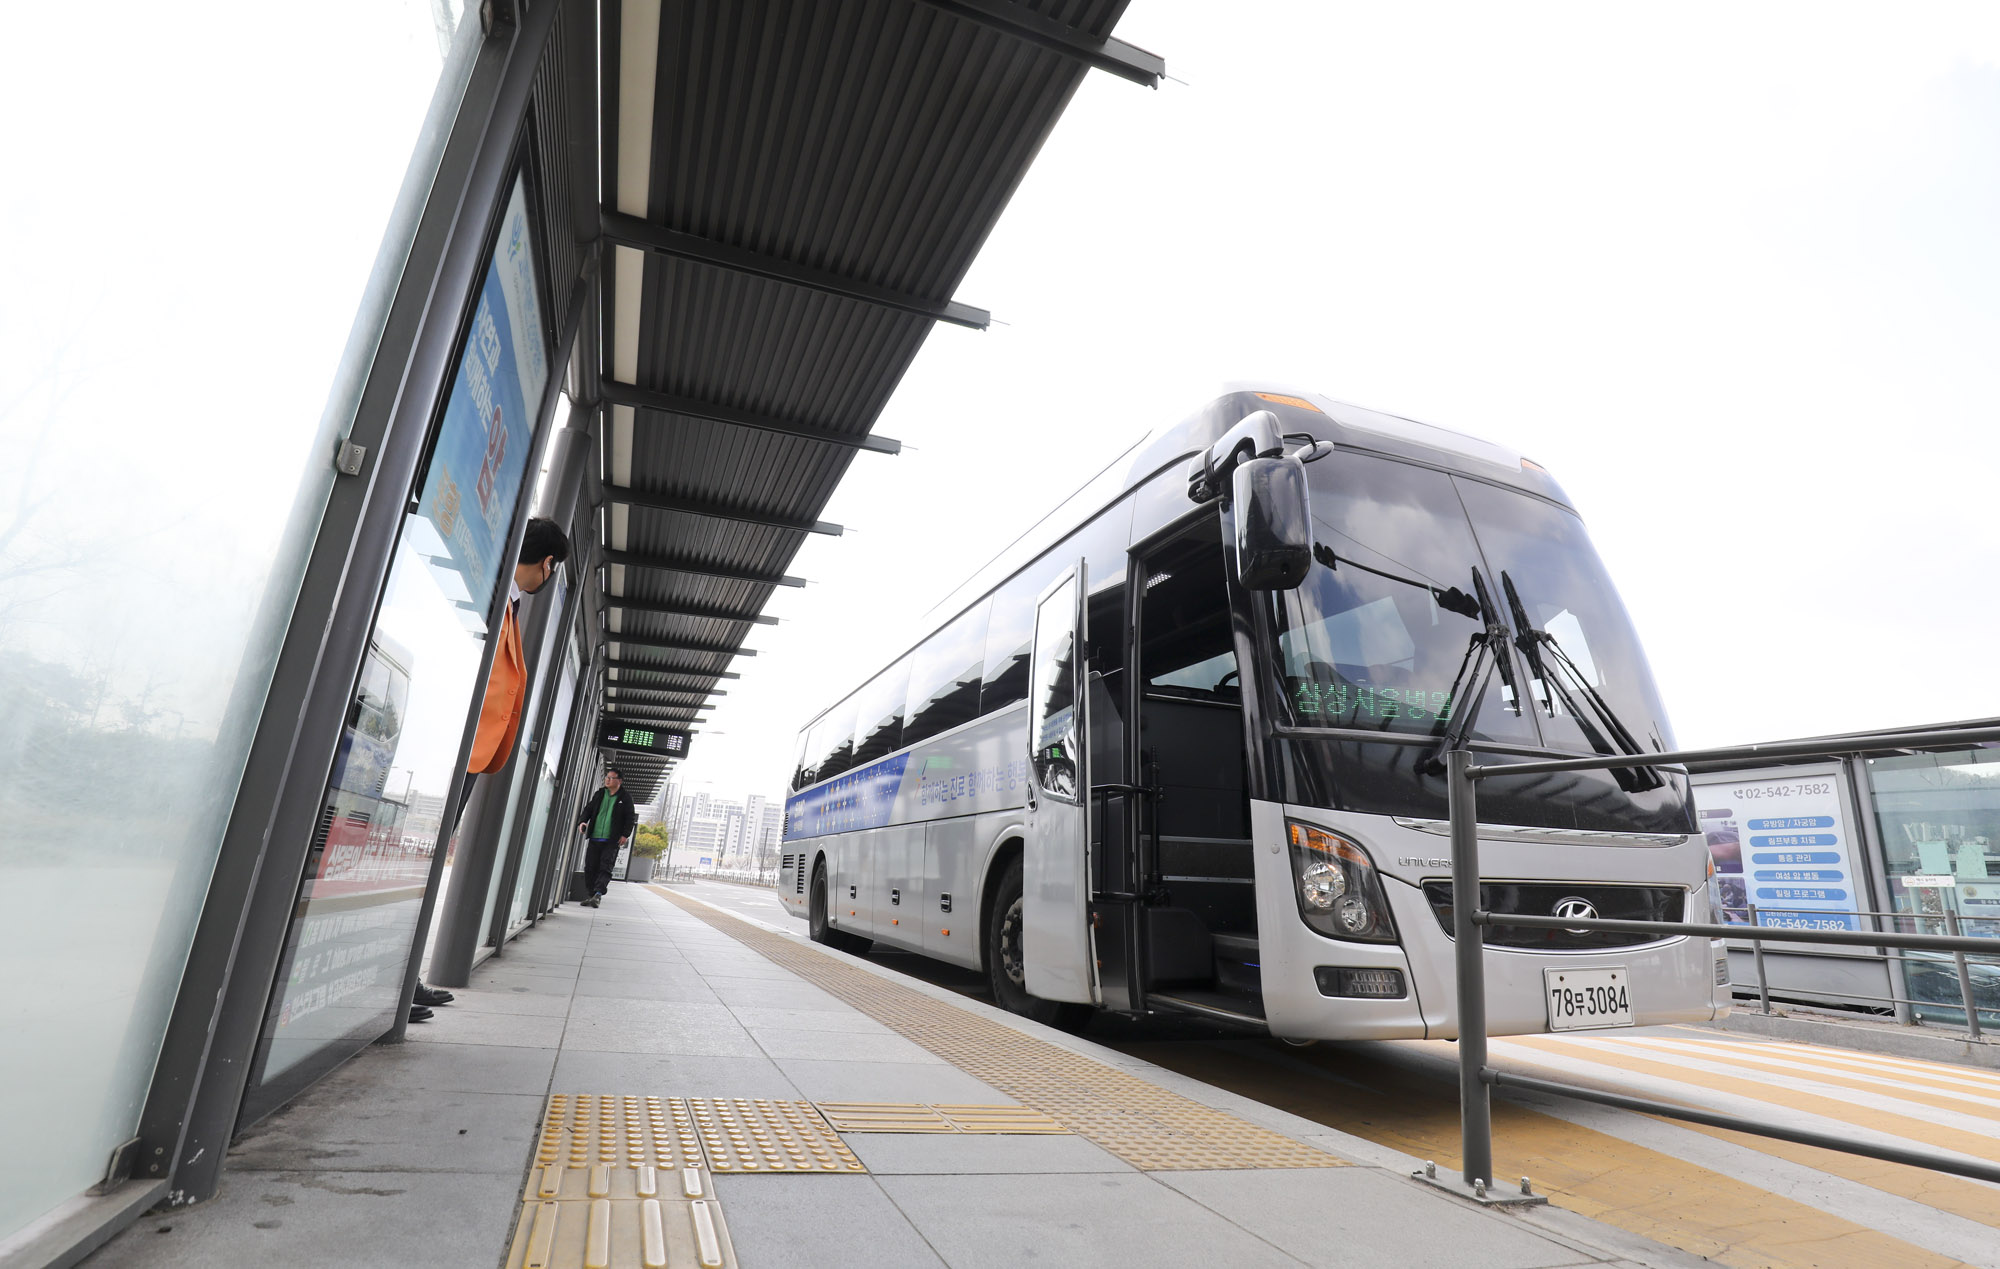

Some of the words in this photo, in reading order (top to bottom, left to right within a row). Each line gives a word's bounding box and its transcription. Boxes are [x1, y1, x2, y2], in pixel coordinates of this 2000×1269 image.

[478, 291, 502, 378] 자연과
[1295, 682, 1453, 721] 삼성서울병원
[921, 780, 948, 806] 함께하는
[950, 776, 965, 801] 진료
[968, 766, 1004, 797] 함께하는
[1745, 783, 1830, 799] 02-542-7582
[1762, 819, 1785, 828] 유방암
[1793, 818, 1817, 827] 자궁암
[1768, 836, 1798, 845] 림프부종
[1800, 836, 1816, 844] 치료
[1795, 854, 1812, 862] 관리
[1775, 872, 1791, 880] 여성
[1793, 872, 1801, 880] 암
[1793, 889, 1826, 899] 프로그램
[1766, 917, 1846, 931] 02-542-7582
[1551, 985, 1630, 1019] 78무3084
